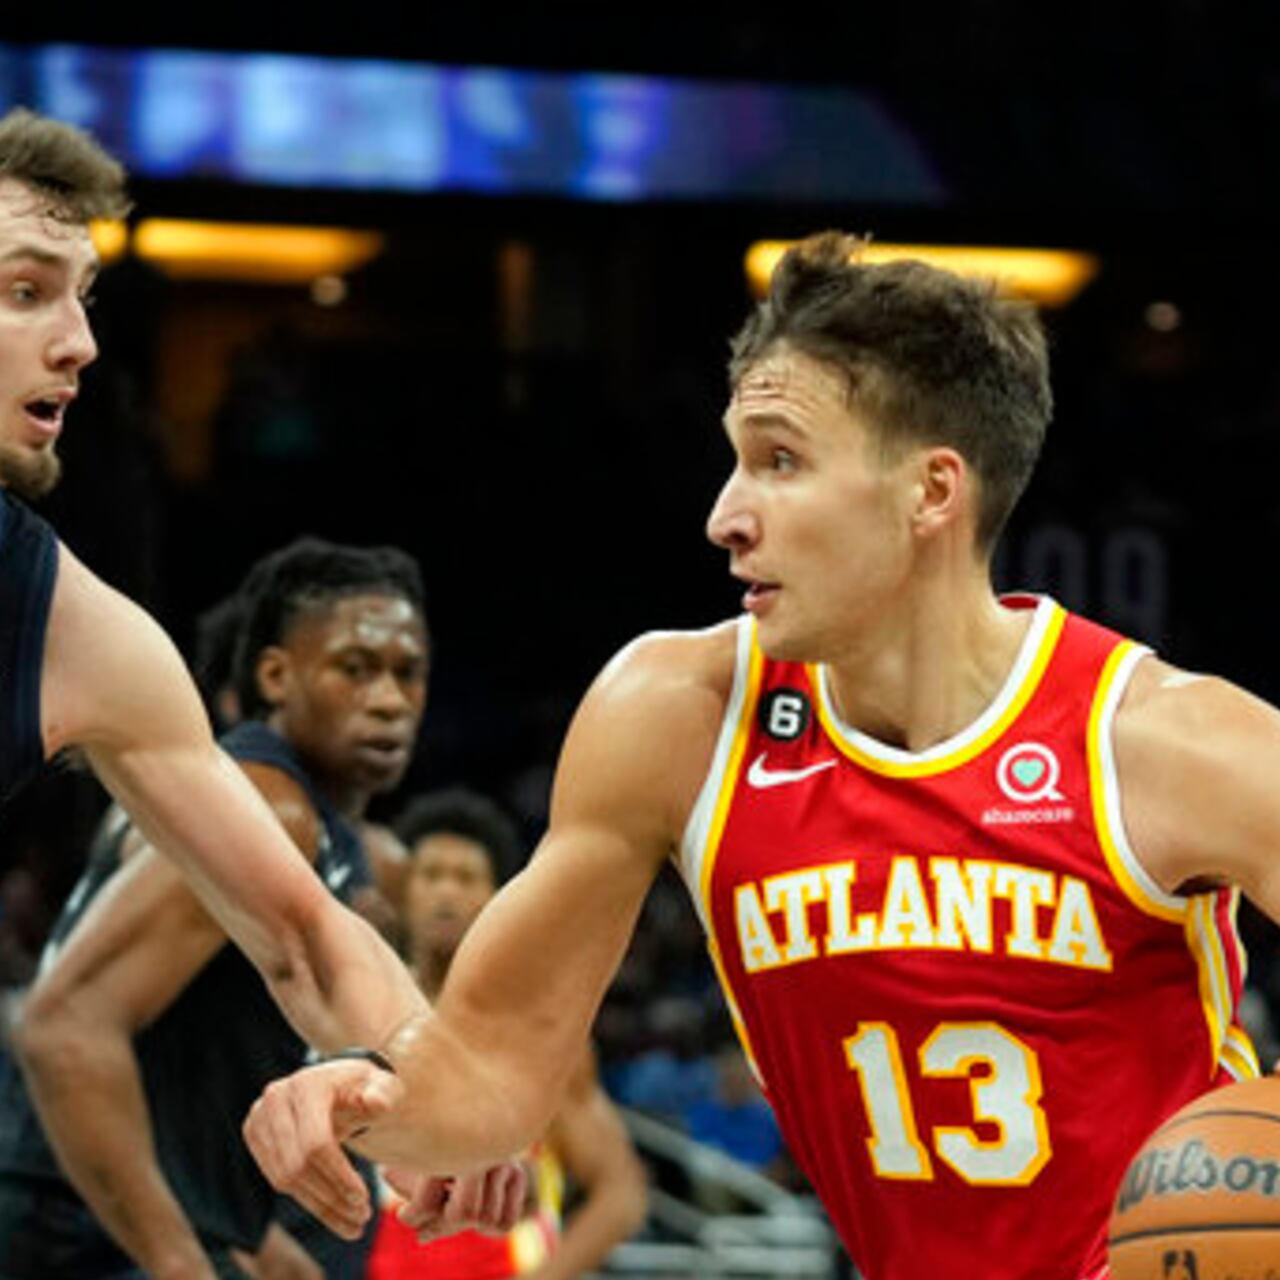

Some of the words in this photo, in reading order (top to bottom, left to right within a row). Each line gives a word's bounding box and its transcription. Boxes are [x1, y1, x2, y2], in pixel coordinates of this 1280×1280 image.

[768, 695, 803, 738] 6
[733, 855, 1113, 974] ATLANTA
[842, 1020, 1053, 1187] 13
